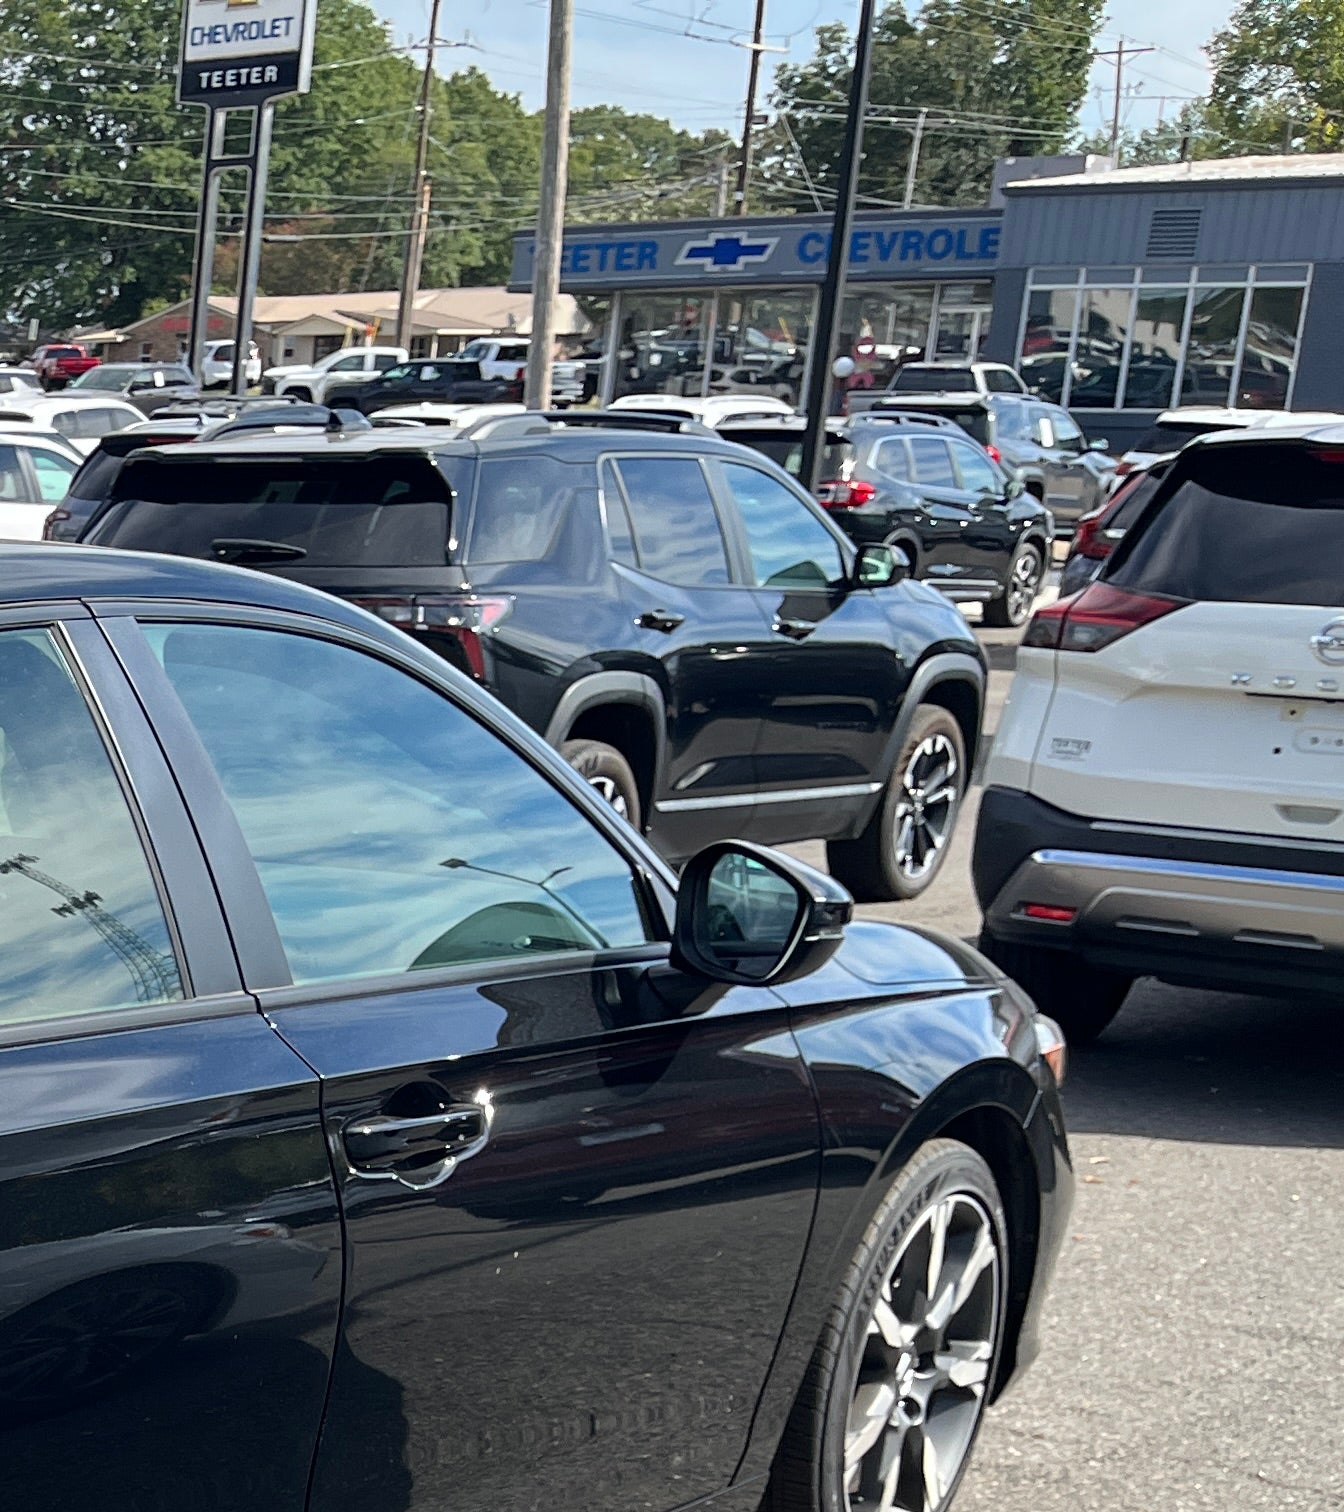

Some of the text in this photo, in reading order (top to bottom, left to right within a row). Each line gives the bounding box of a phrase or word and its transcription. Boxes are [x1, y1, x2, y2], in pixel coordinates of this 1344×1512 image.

[190, 16, 294, 46] CHEVROLET
[199, 65, 279, 90] TEETER
[528, 240, 659, 273] EETER
